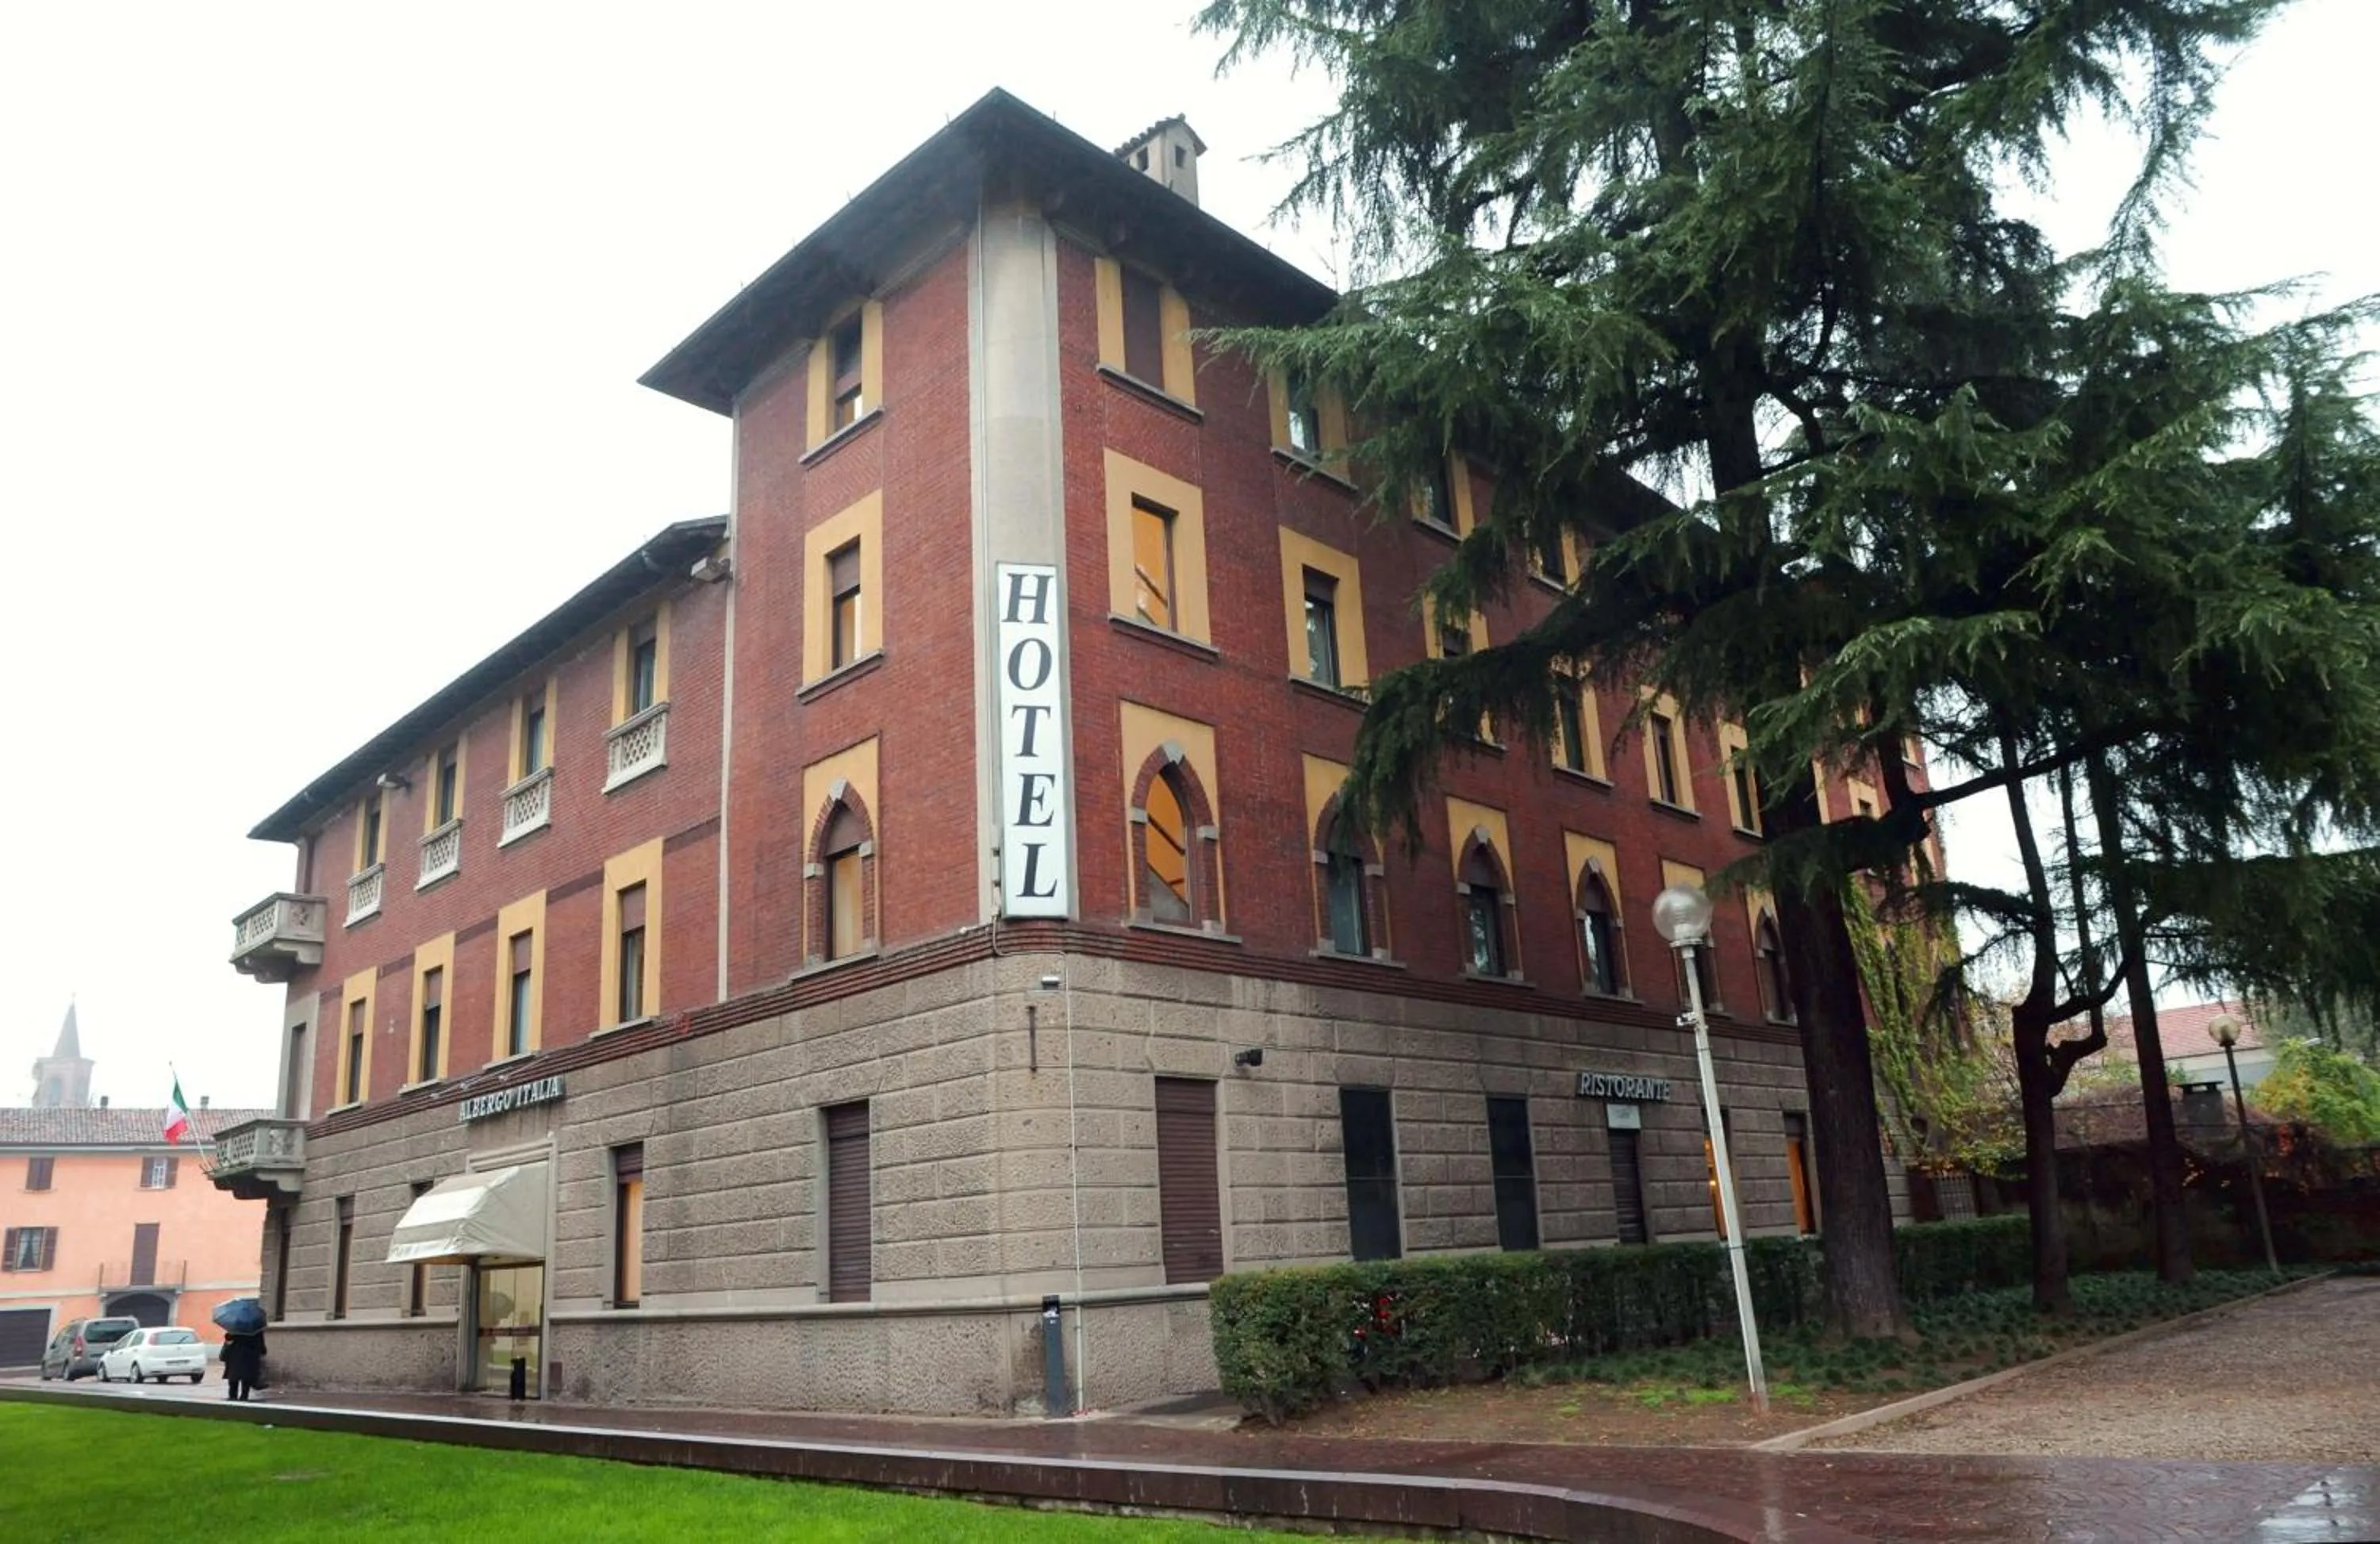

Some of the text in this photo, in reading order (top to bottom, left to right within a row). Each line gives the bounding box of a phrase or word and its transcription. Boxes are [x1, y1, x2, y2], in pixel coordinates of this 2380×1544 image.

[1001, 572, 1058, 898] HOTEL
[459, 1074, 559, 1121] ALBERGO ITALIA
[1580, 1072, 1671, 1100] RISTORANTE
